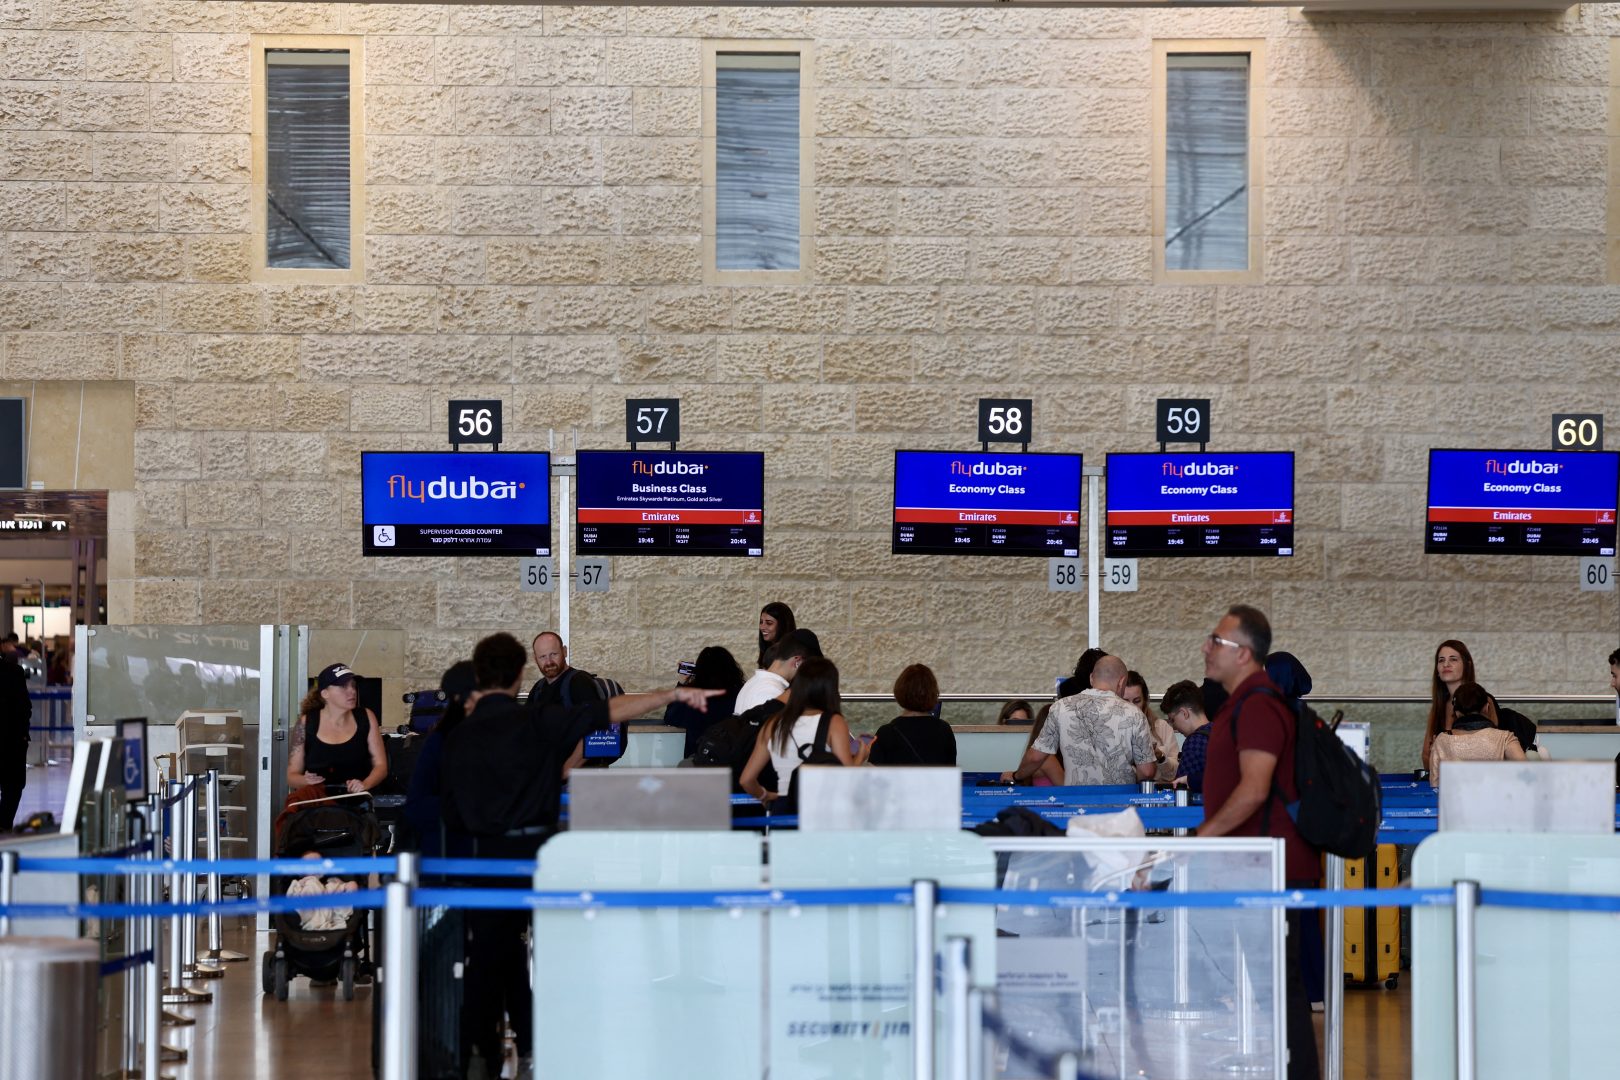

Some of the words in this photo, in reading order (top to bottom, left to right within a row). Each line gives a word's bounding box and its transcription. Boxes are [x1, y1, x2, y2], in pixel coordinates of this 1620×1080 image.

[458, 409, 492, 436] 56
[636, 408, 668, 434] 57
[988, 408, 1022, 434] 58
[1166, 408, 1200, 434] 59
[1558, 418, 1597, 446] 60
[632, 460, 705, 477] flydubai
[950, 461, 1023, 477] flydubai
[1162, 462, 1235, 478] flydubai
[1486, 460, 1559, 476] flydubai
[386, 475, 519, 503] flydubai
[632, 483, 677, 493] Business
[679, 483, 706, 493] Class
[949, 484, 996, 496] Economy
[998, 485, 1025, 495] Class
[1161, 485, 1208, 497] Economy
[1210, 485, 1237, 495] Class
[1484, 483, 1531, 494] Economy
[1533, 484, 1562, 493] Class
[642, 512, 680, 521] Emirates
[959, 512, 996, 522] Emirates
[1172, 513, 1210, 522] Emirates
[1493, 512, 1532, 520] Emirates
[528, 565, 548, 585] 56
[583, 565, 602, 584] 57
[1056, 564, 1076, 584] 58
[1112, 564, 1131, 584] 59
[1587, 564, 1607, 584] 60
[788, 1021, 872, 1036] SECURITY
